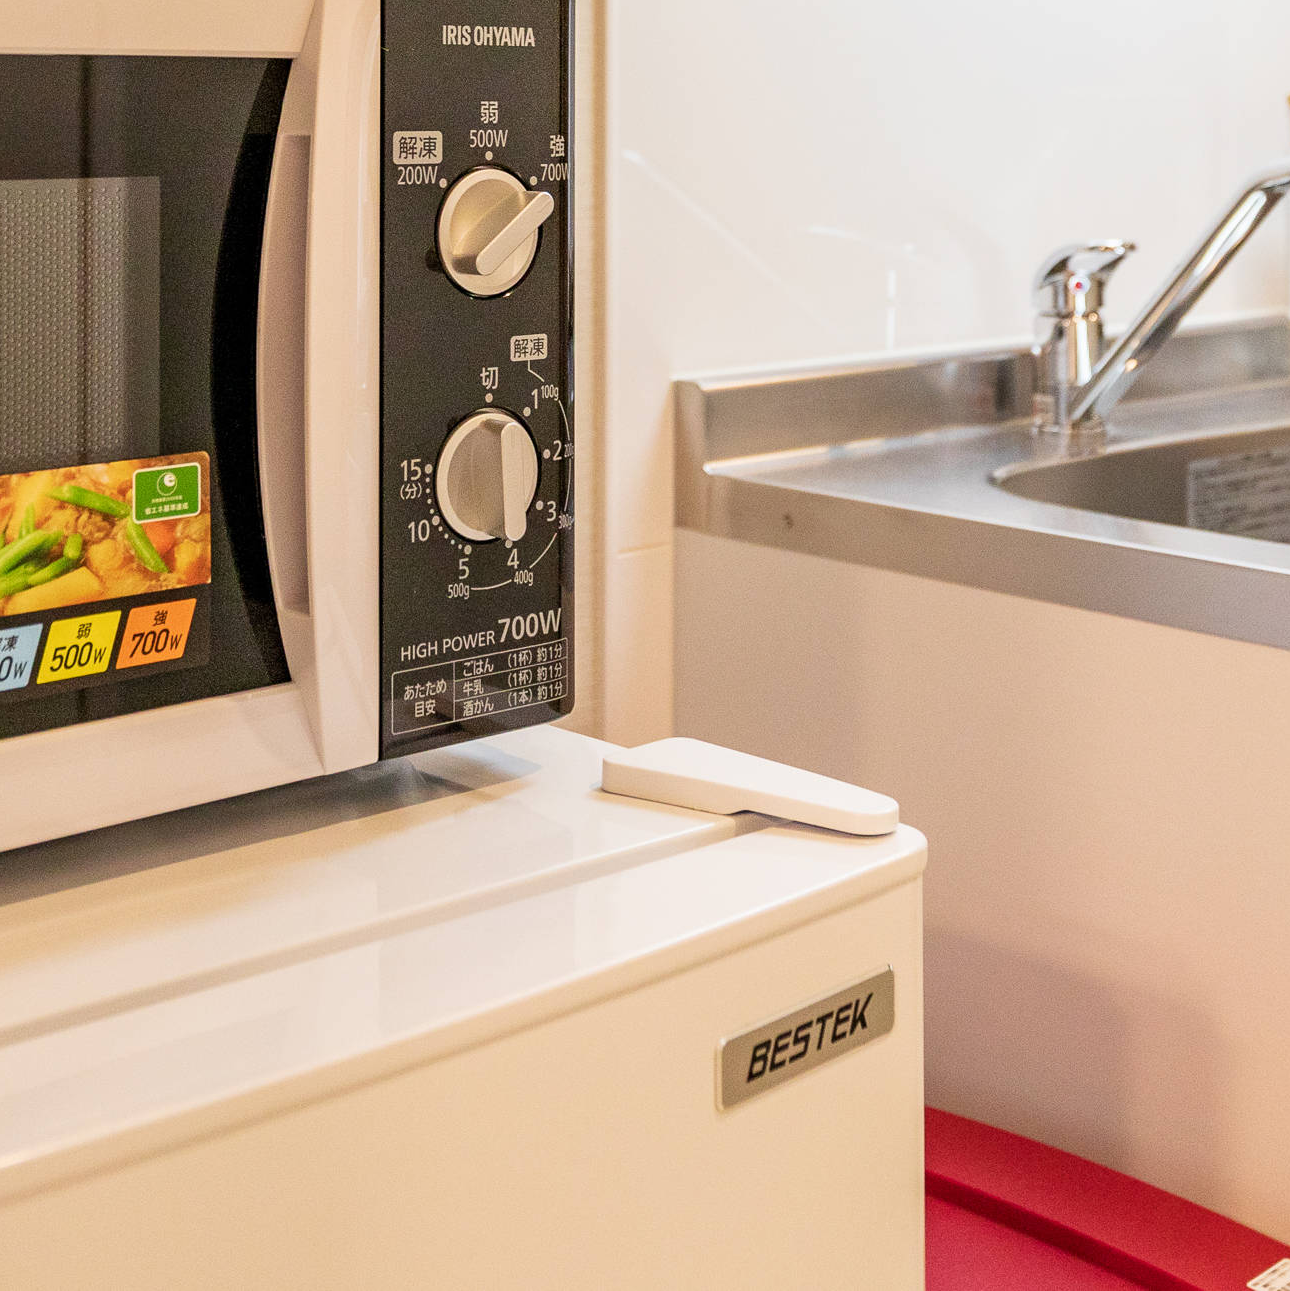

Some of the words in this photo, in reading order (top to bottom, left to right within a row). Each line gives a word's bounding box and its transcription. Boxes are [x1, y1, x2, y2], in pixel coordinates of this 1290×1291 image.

[442, 25, 471, 46] IRIS
[473, 25, 536, 47] OHYAMA
[480, 101, 499, 124] 弱
[398, 136, 438, 159] 解凍
[469, 129, 508, 148] 500W
[550, 134, 566, 157] 強
[397, 166, 438, 185] 200W
[513, 337, 545, 359] 解凍
[479, 367, 499, 390] 切
[531, 389, 538, 409] 1
[541, 384, 559, 401] 100g
[553, 440, 562, 461] 2
[400, 459, 422, 481] 15
[400, 482, 422, 500] (分)
[546, 501, 557, 522] 3
[408, 519, 430, 543] 10
[459, 558, 470, 580] 5
[507, 549, 520, 569] 4
[513, 570, 534, 587] 400g
[447, 582, 470, 600] 500g
[153, 610, 168, 627] 強
[76, 622, 93, 640] 弱
[400, 640, 438, 661] HIGH
[442, 630, 496, 654] POWER
[498, 608, 562, 643] 700W
[129, 628, 183, 659] 700W
[49, 641, 107, 673] 500W
[462, 658, 494, 678] ごはん
[537, 643, 562, 663] 約1分
[403, 679, 447, 701] あたため
[462, 679, 484, 697] 牛乳
[537, 662, 563, 682] 約1分
[414, 700, 436, 718] 目安
[462, 699, 494, 717] 酒かん
[537, 681, 563, 701] 約1分
[746, 992, 874, 1083] BESTEK
